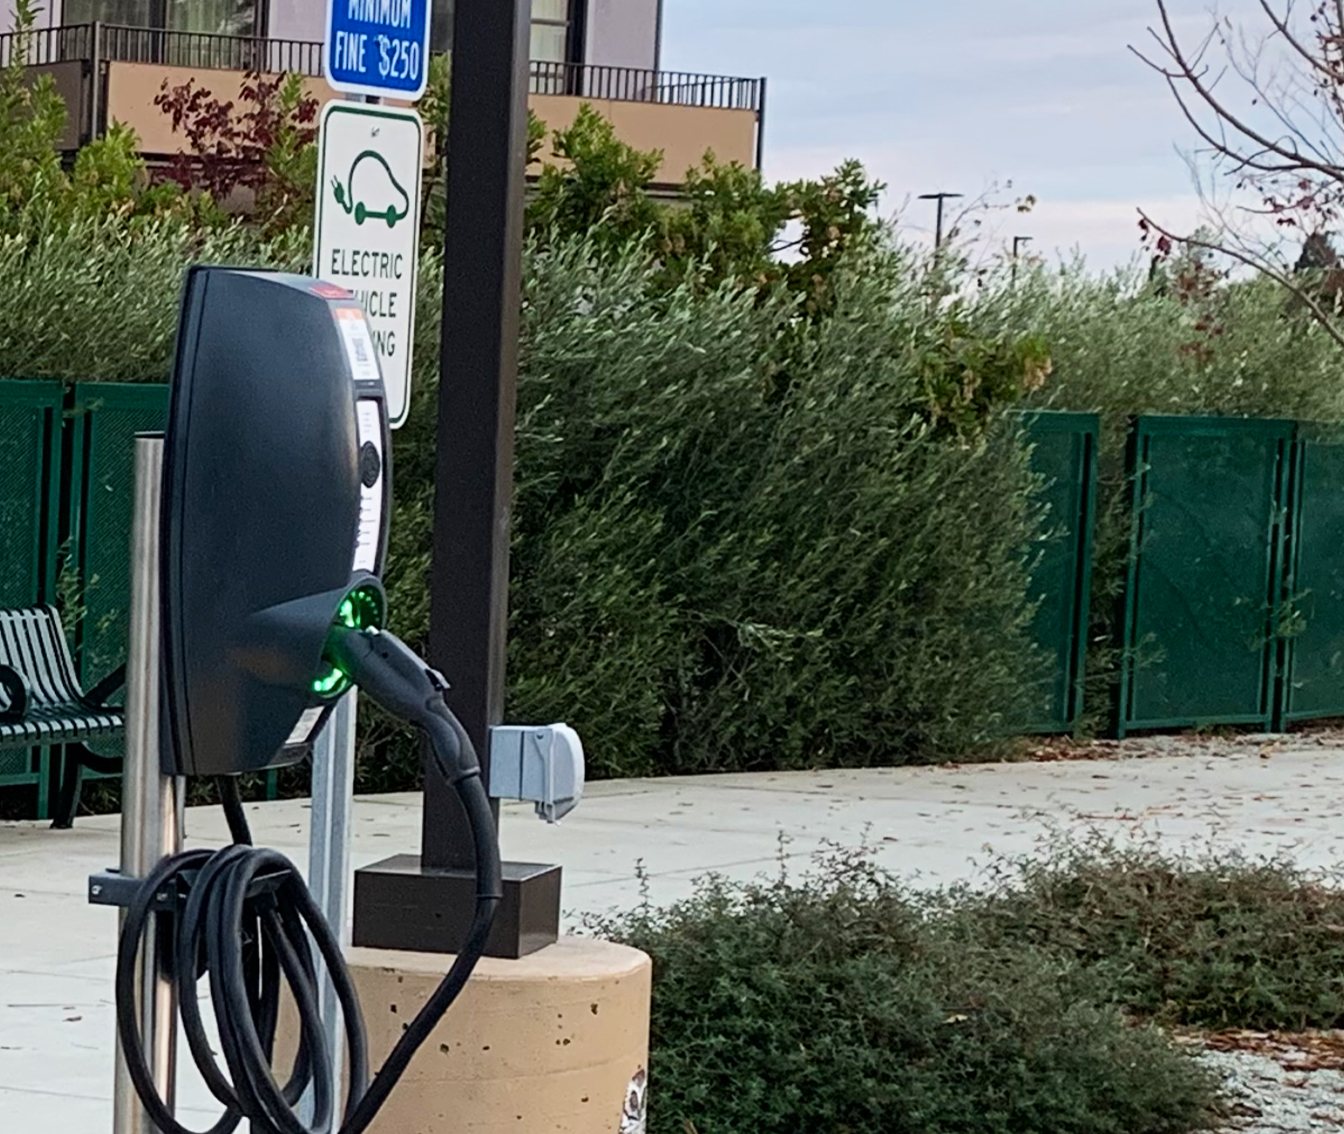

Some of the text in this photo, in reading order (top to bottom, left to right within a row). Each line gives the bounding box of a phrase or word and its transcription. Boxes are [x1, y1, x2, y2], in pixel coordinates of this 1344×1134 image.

[334, 30, 420, 81] FINE $250
[331, 248, 404, 280] ELECTRIC
[348, 289, 398, 318] ICLE
